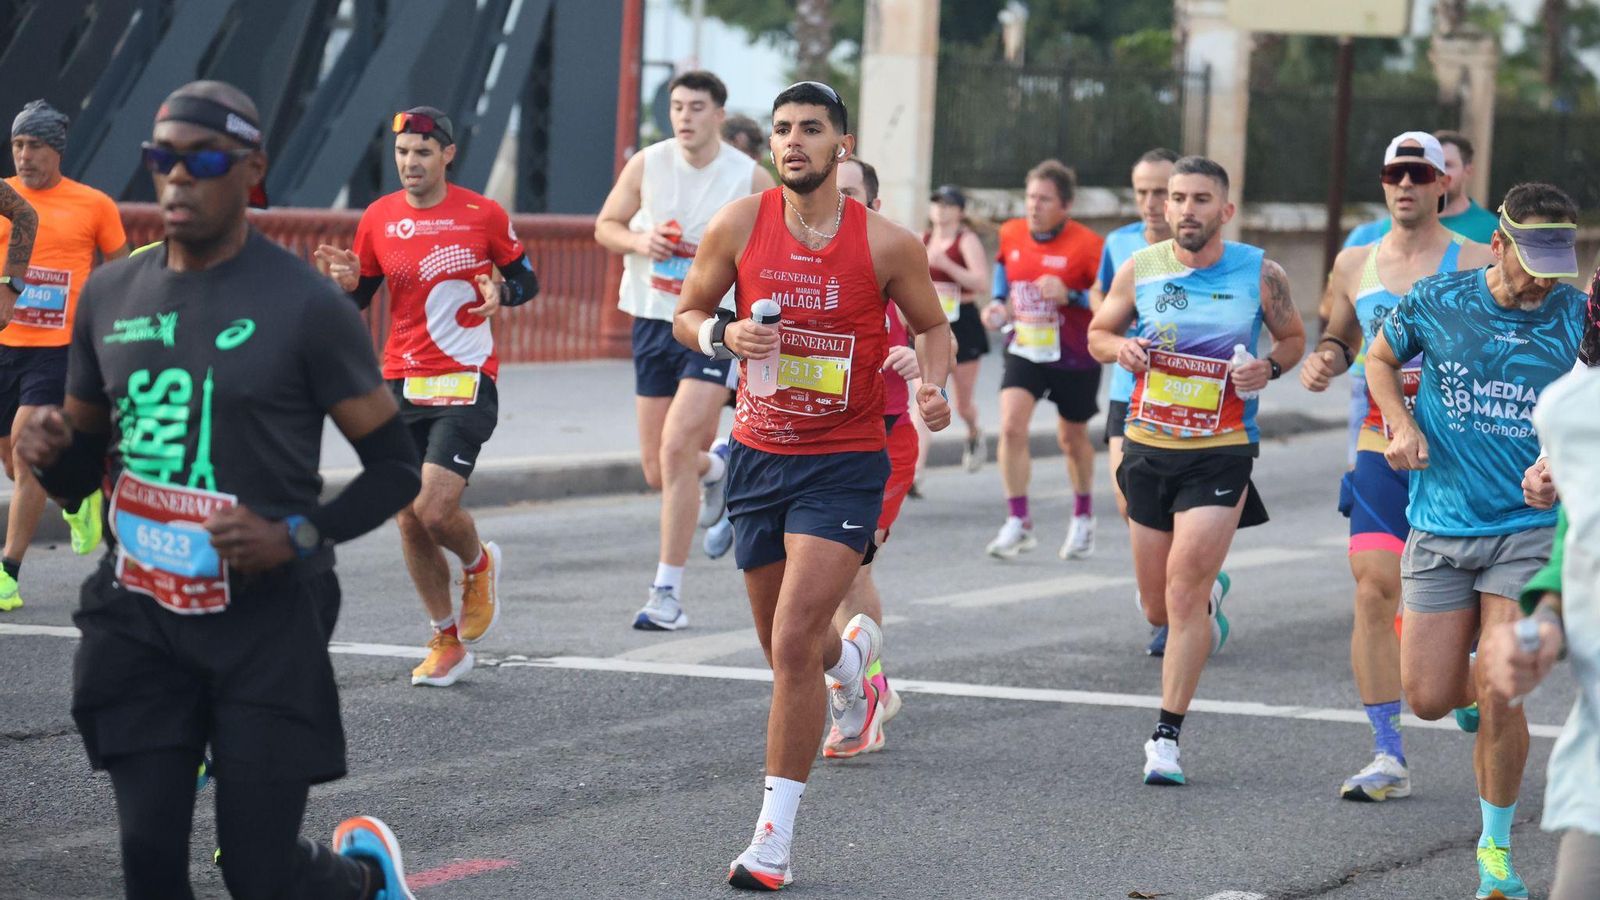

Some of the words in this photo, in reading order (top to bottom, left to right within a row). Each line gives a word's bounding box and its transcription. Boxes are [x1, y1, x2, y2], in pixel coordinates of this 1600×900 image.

[790, 253, 814, 262] luanvi
[773, 270, 823, 285] GENERALI
[772, 290, 821, 310] MÁLAGA
[781, 332, 845, 352] GENERALI
[779, 358, 824, 380] 7513
[1163, 379, 1203, 398] 2907
[1440, 384, 1471, 413] 38
[1473, 378, 1537, 403] MEDIA
[815, 397, 832, 406] 42K
[1473, 398, 1534, 421] MARA
[128, 368, 193, 487] ARIS
[136, 525, 191, 558] 6523
